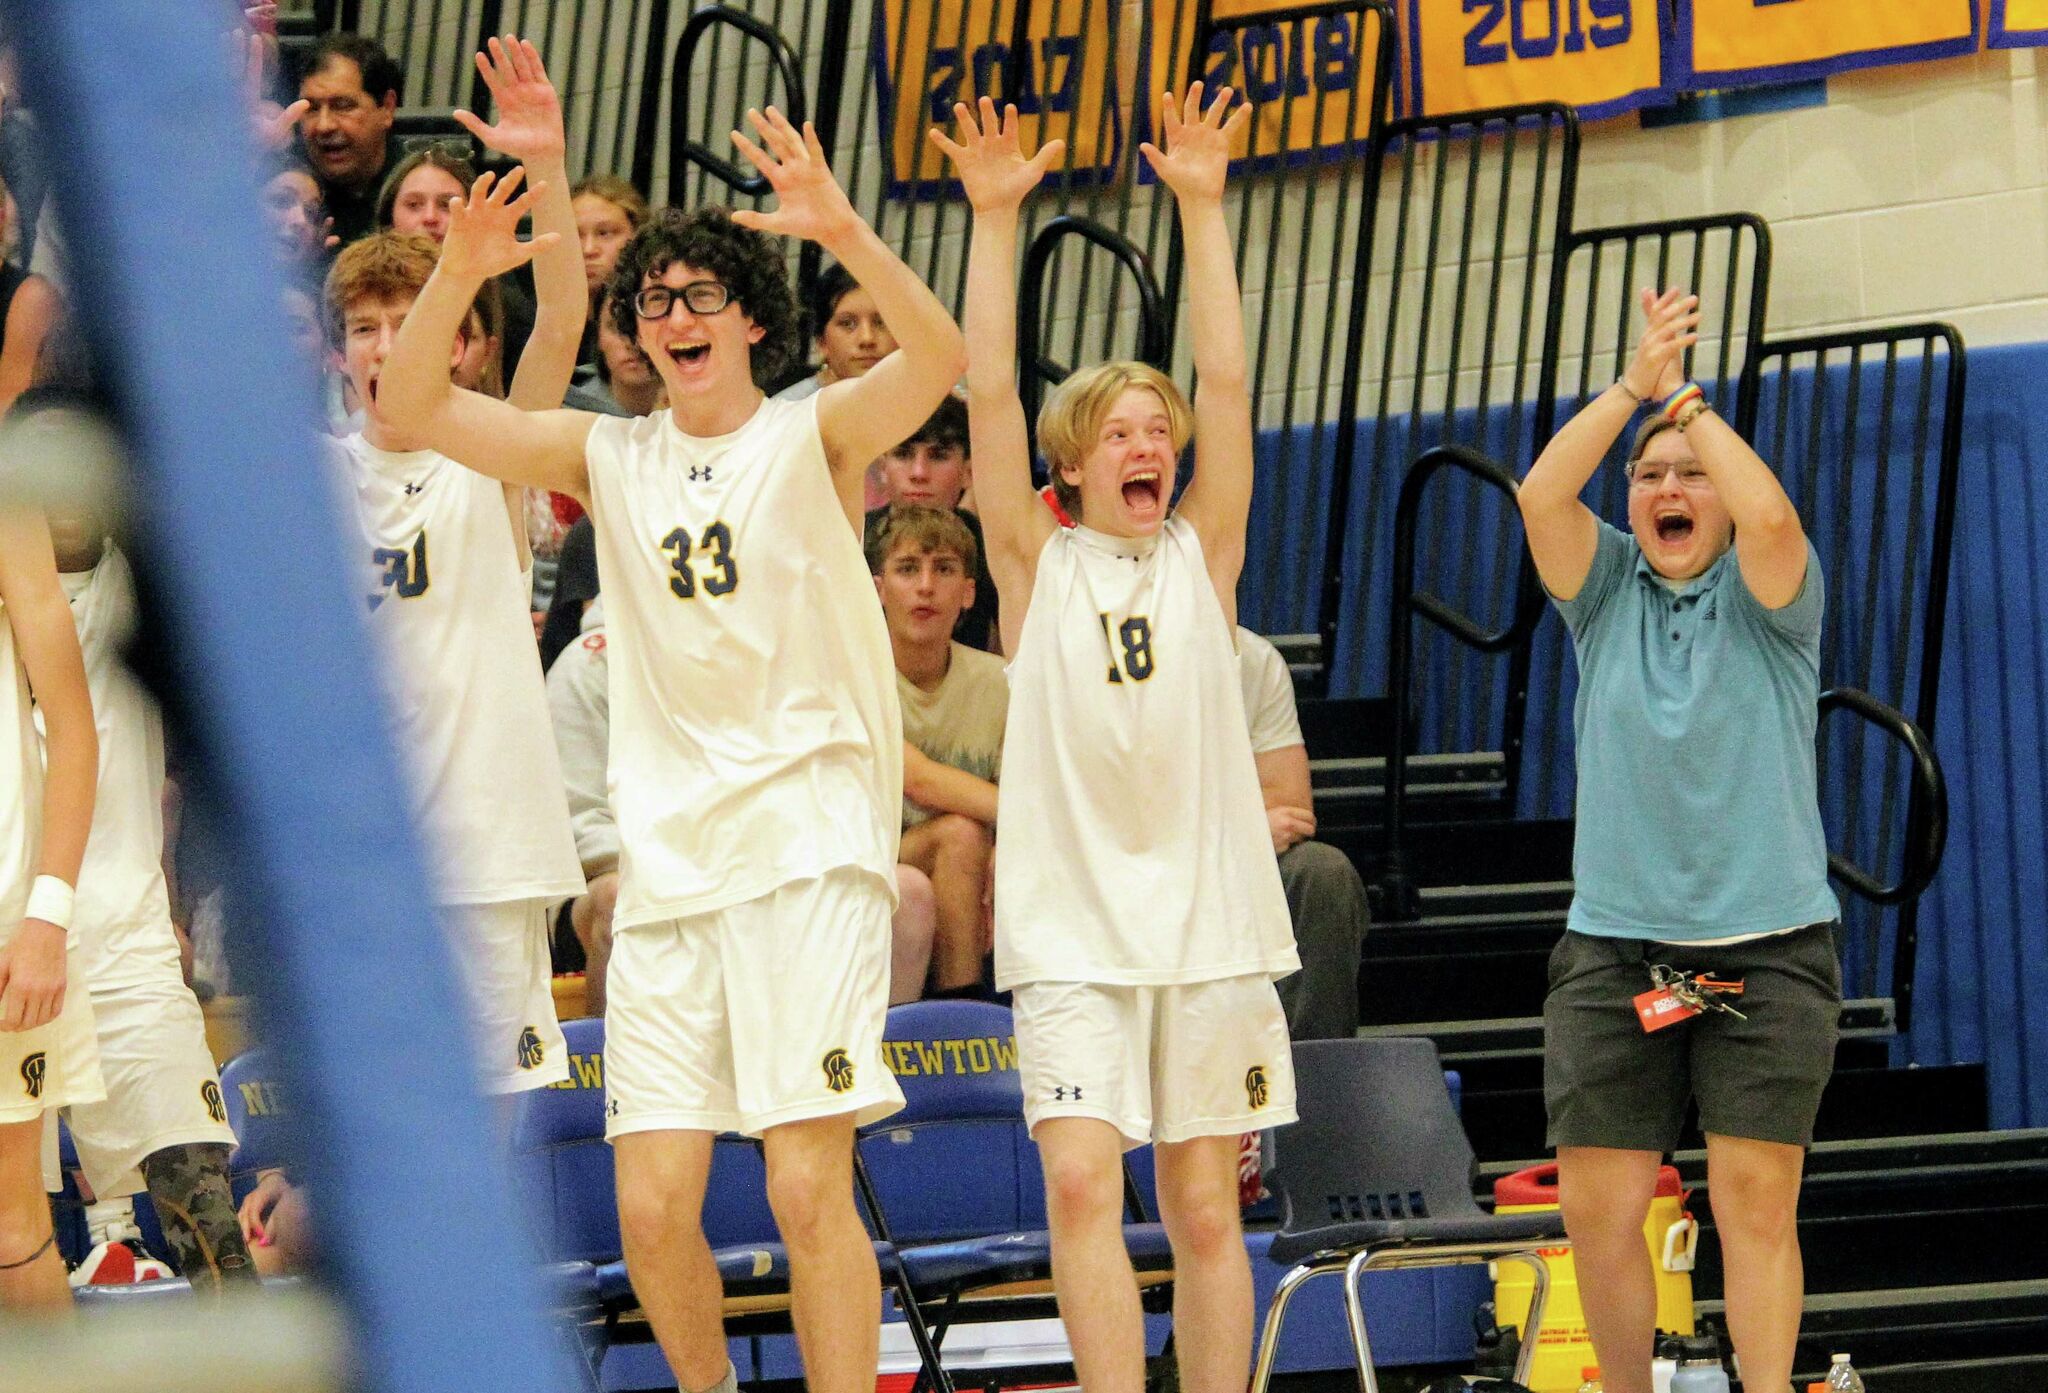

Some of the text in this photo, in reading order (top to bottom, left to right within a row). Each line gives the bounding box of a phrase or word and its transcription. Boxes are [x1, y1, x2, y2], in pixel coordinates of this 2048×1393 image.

[1202, 14, 1356, 111] 2018
[1463, 0, 1632, 66] 2019
[928, 36, 1088, 122] 2017
[661, 520, 739, 599] 33
[1099, 612, 1155, 684] 18
